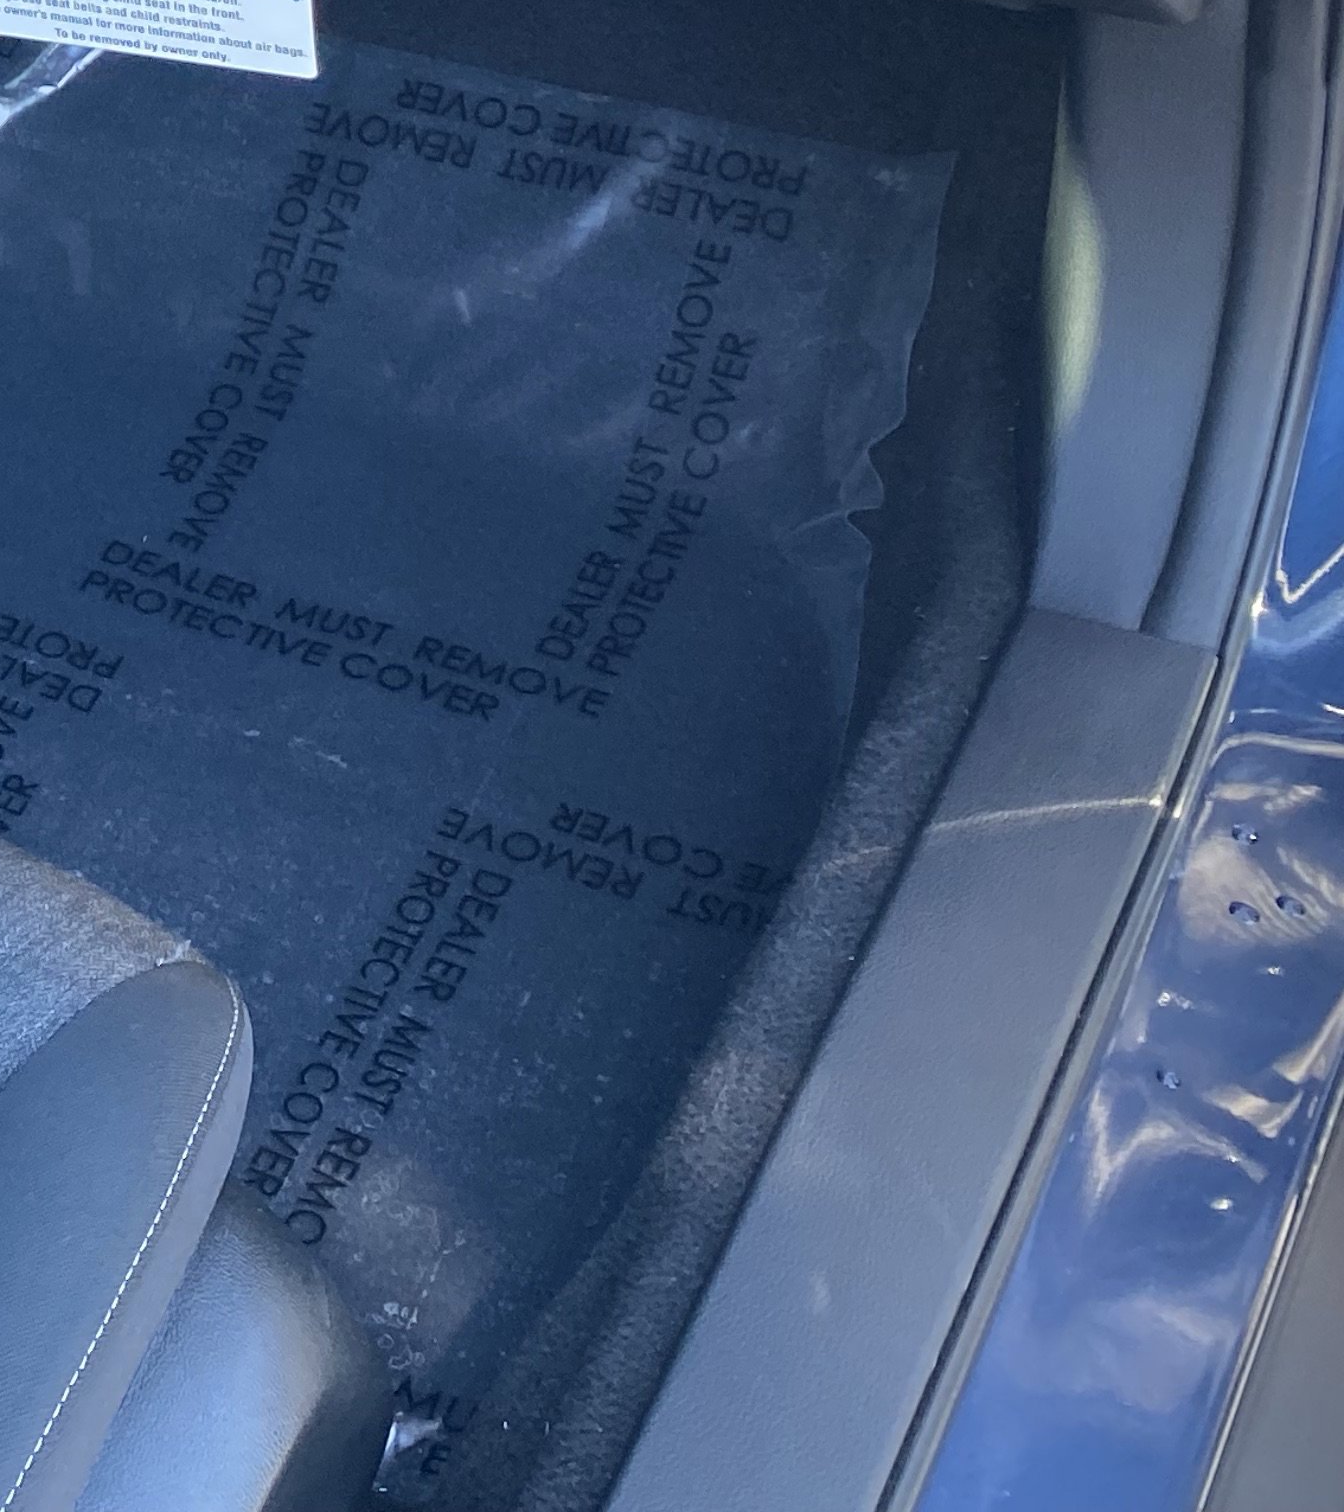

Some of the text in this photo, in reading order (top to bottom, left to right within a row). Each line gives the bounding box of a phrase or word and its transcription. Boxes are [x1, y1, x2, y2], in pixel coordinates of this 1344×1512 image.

[3, 4, 47, 19] owner's
[50, 11, 92, 26] manual
[95, 17, 112, 28] for
[114, 21, 145, 33] more
[147, 24, 214, 43] information
[218, 35, 251, 49] about
[255, 41, 271, 51] air
[275, 43, 307, 58] bags.
[54, 27, 231, 62] To be removed by owner only.
[73, 0, 102, 13] belts
[104, 5, 127, 17] and
[130, 8, 159, 22] child
[163, 14, 225, 31] restraints.
[173, 1, 185, 12] in
[188, 3, 207, 15] the
[211, 7, 244, 20] front.
[304, 101, 795, 244] DEALER MUST REMOVE
[396, 78, 812, 198] PROTECTIVE COVER
[159, 149, 327, 484] PROTECTIVE COVER
[168, 158, 369, 554] DEALER MUST REMOVE
[535, 238, 732, 662] DEALER MUST REMOVE
[585, 331, 758, 677] PROTECTIVE COVER
[78, 569, 502, 722] PROTECTIVE COVER
[100, 539, 613, 721] DEALER MUST REMOVE
[436, 806, 645, 901] REMOVE
[549, 803, 725, 880] COVER
[243, 850, 461, 1200] PROTECTIVE COVER
[352, 867, 513, 1116] DEALER MUST
